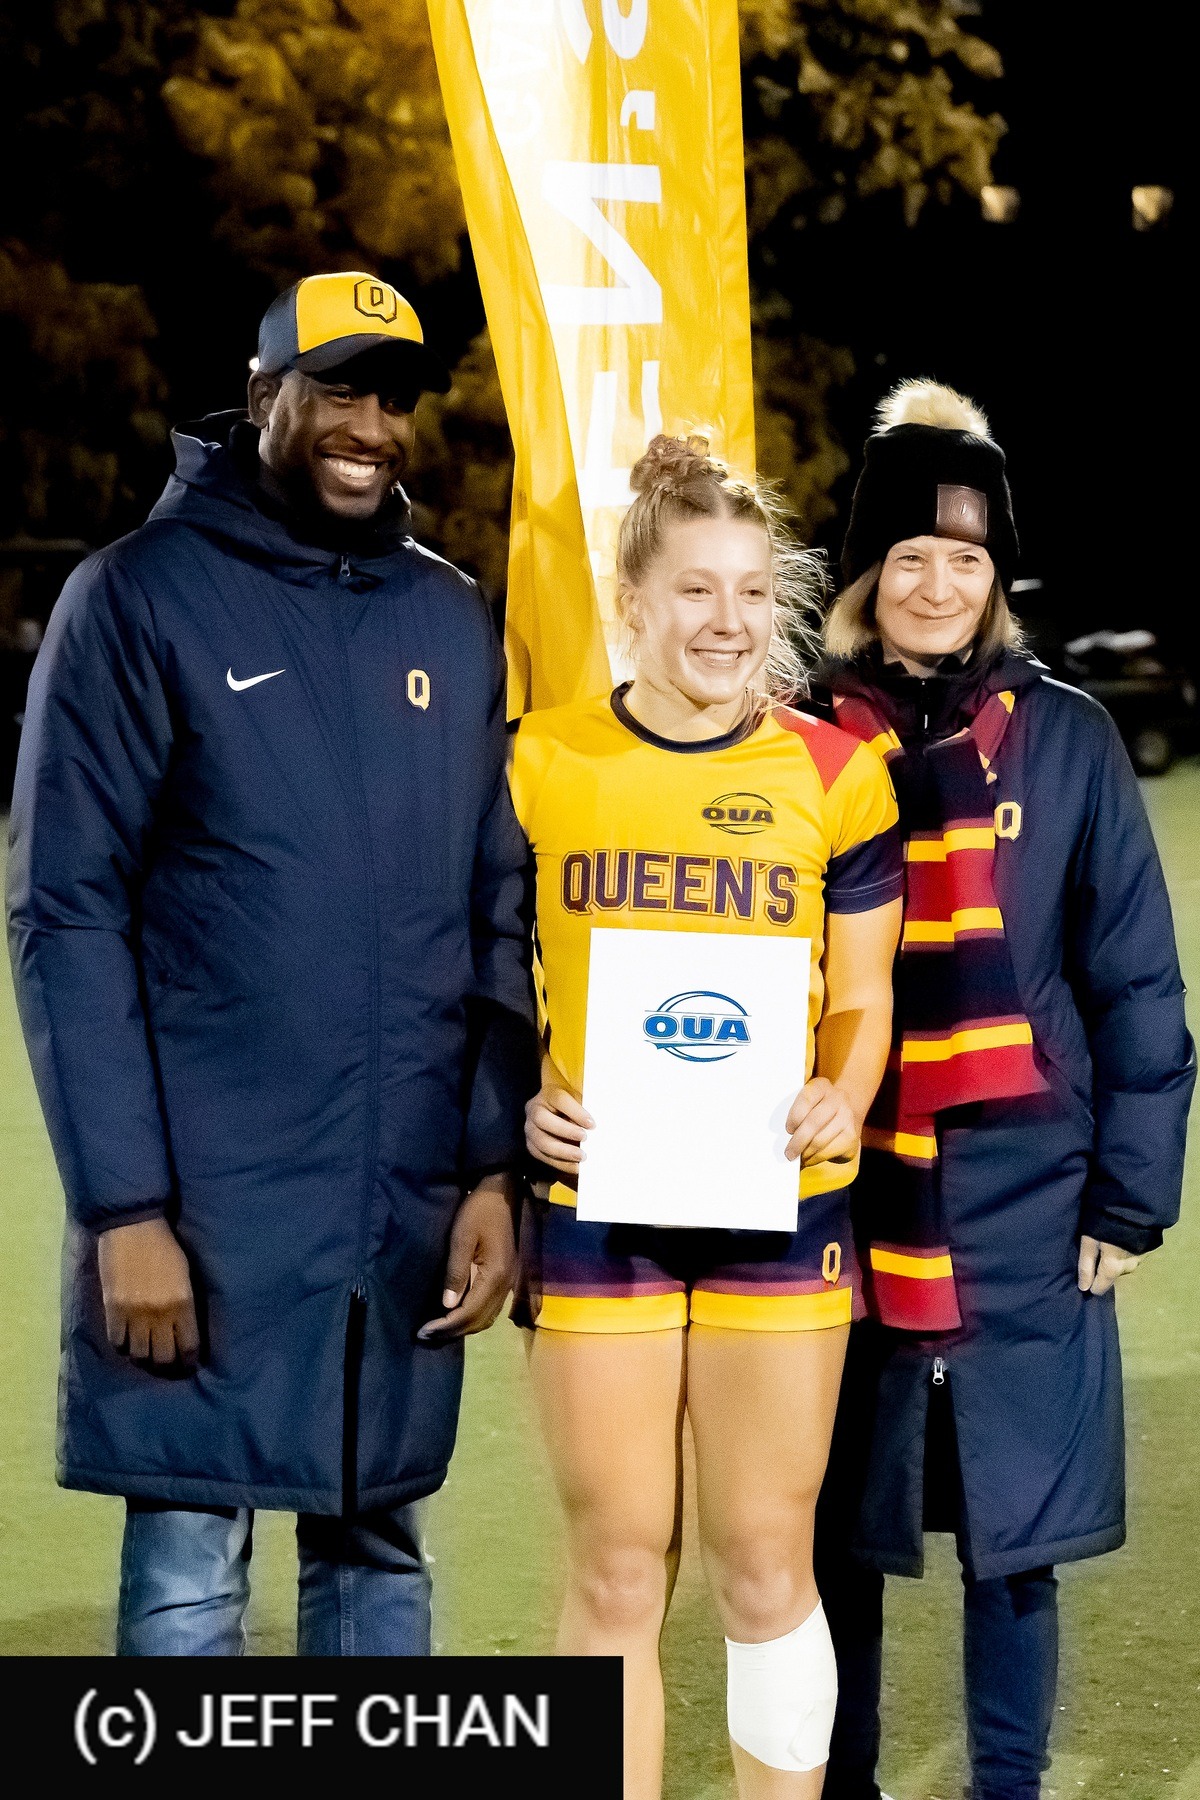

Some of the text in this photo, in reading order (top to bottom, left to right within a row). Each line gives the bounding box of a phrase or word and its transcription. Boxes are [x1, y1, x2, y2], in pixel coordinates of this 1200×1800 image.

[354, 278, 398, 324] Q
[406, 668, 432, 711] Q
[701, 804, 776, 824] OUA
[994, 801, 1023, 840] Q
[561, 849, 799, 926] QUEEN'S
[643, 1013, 751, 1043] OUA
[821, 1241, 842, 1287] Q
